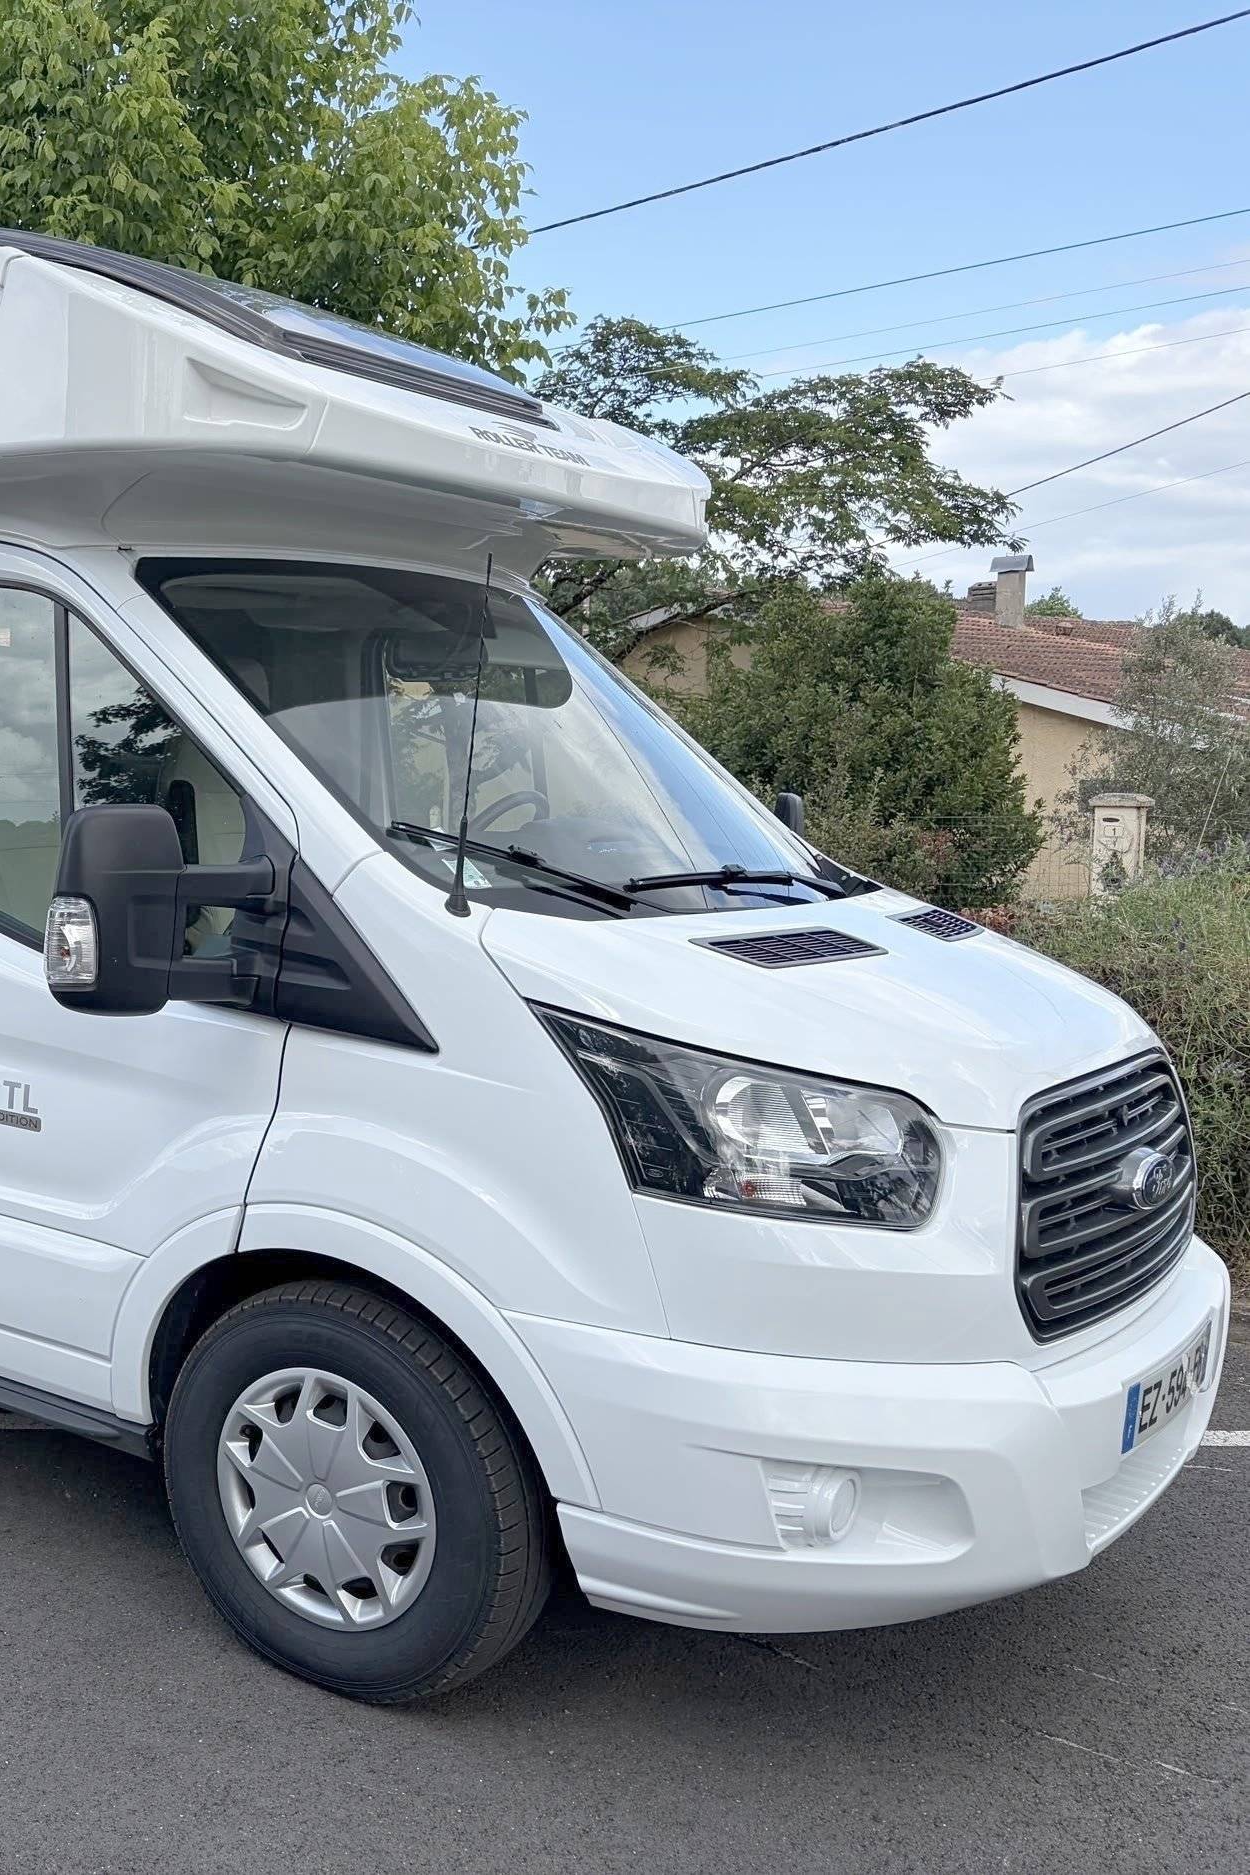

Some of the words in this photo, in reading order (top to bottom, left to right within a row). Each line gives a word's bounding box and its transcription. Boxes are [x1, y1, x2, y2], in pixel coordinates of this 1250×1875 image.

[468, 425, 542, 454] ROLLER
[537, 443, 591, 467] TEAM
[2, 1079, 39, 1115] TL
